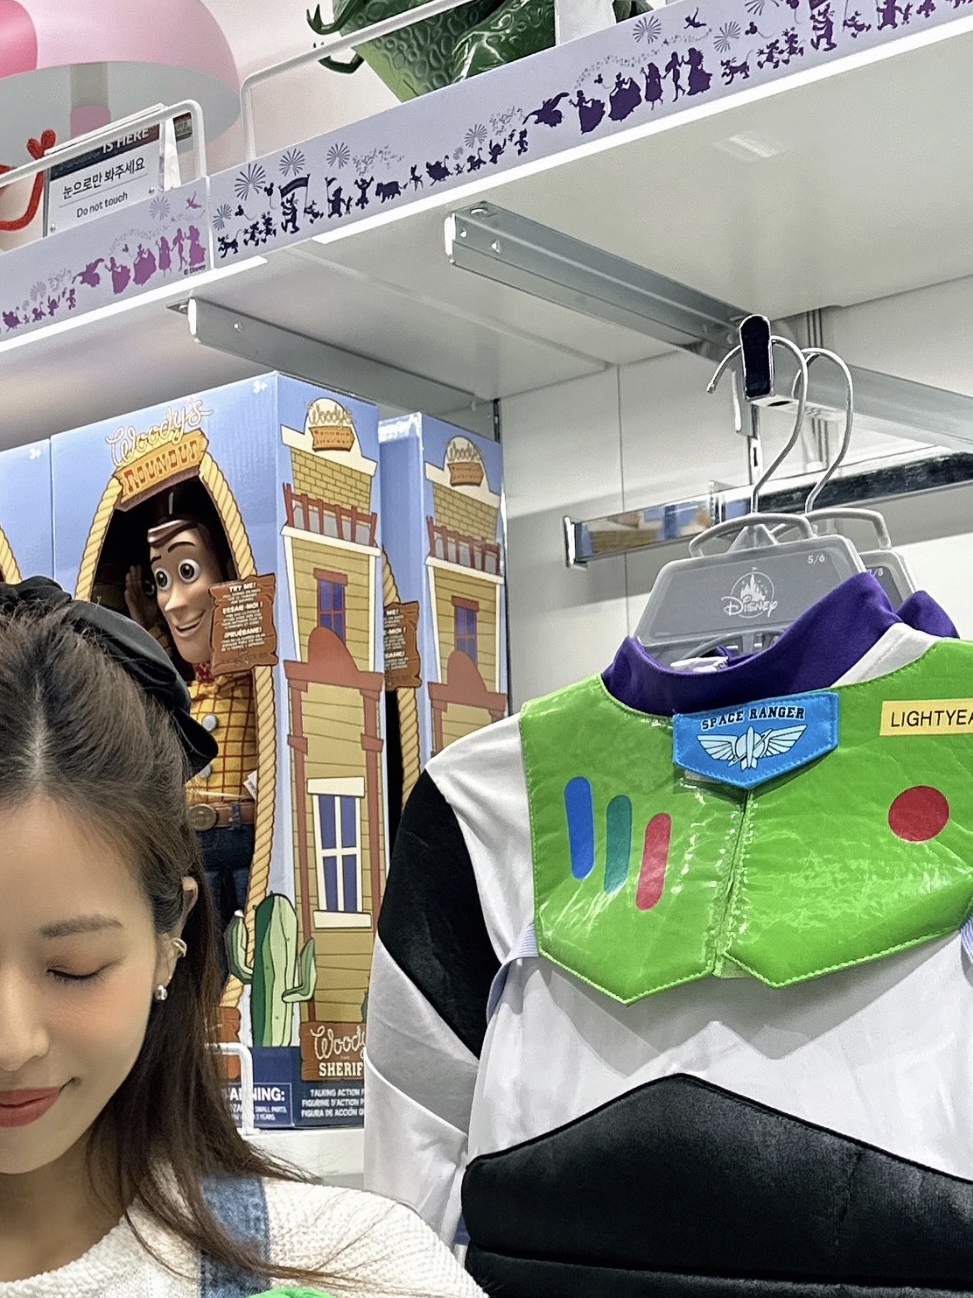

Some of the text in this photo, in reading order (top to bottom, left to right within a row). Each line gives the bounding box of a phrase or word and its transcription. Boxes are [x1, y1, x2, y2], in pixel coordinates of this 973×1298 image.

[117, 127, 150, 149] HERE
[62, 172, 103, 200] 눈으로만
[104, 156, 145, 183] 봐주세요
[76, 191, 128, 218] Do not touch
[105, 398, 214, 468] Woody's
[123, 439, 198, 494] ROUNDUP
[700, 706, 806, 731] SPACE RANGER
[319, 1061, 364, 1077] SHERIF
